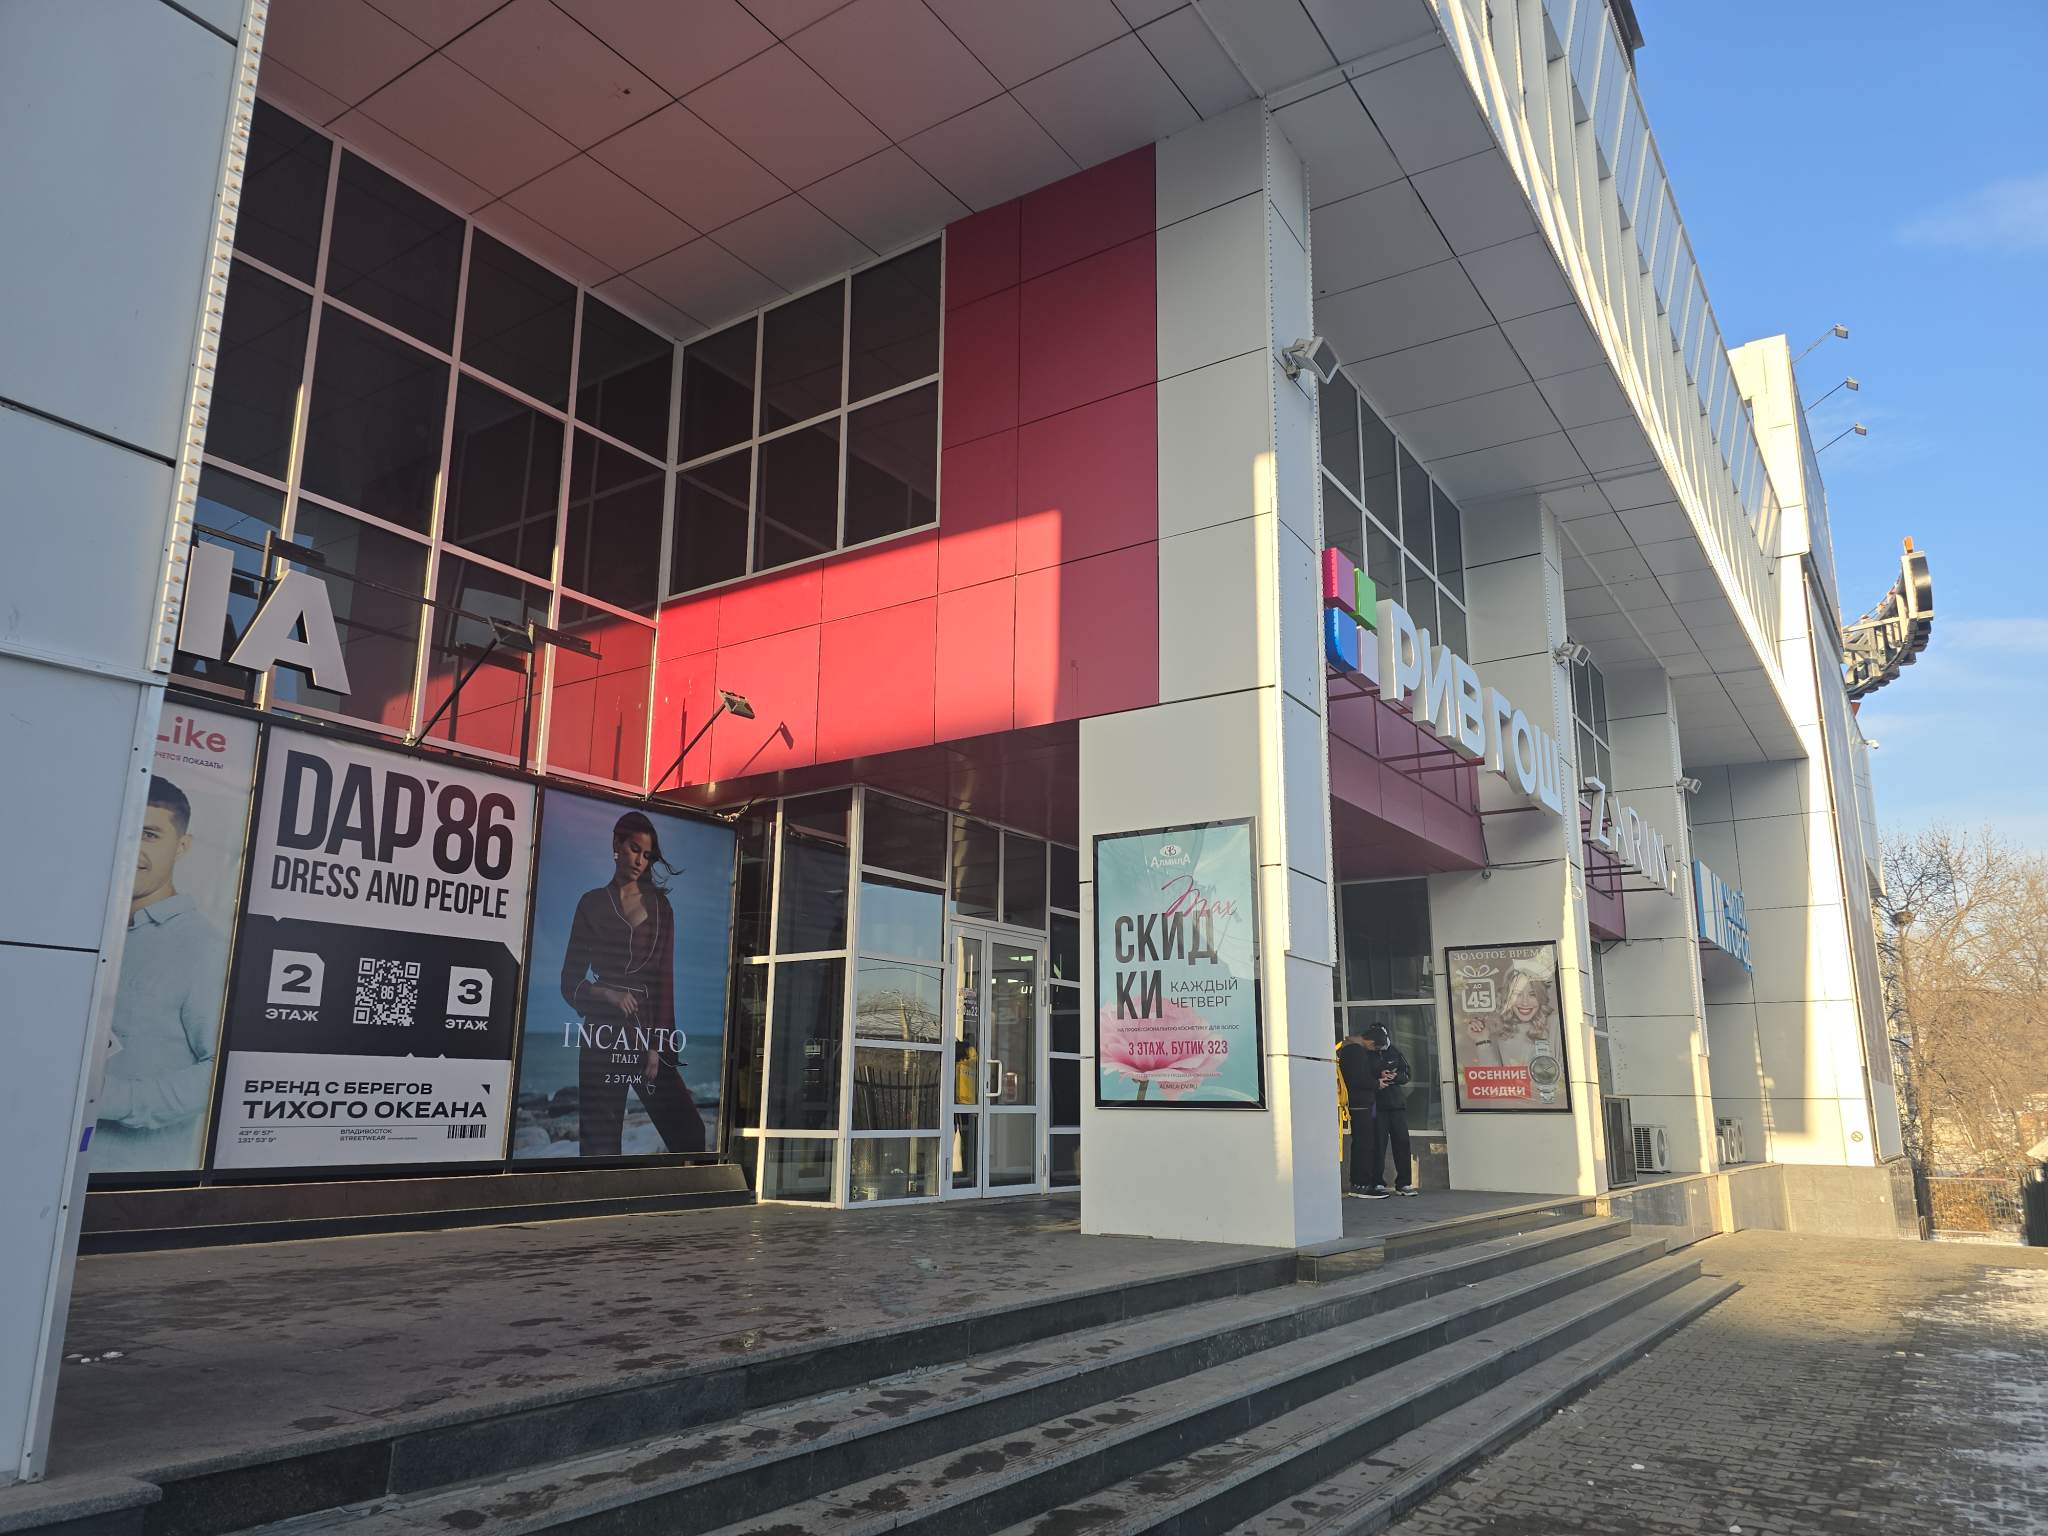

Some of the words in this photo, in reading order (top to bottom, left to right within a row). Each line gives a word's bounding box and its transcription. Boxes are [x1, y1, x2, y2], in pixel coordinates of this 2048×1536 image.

[271, 858, 360, 902] DRESS
[365, 871, 419, 908] AND
[424, 878, 509, 920] PEOPLE
[1114, 908, 1219, 966] СКИД
[1454, 951, 1507, 961] ЗОЛОТОЕ
[281, 963, 313, 994] 2
[1170, 976, 1238, 994] КАЖДЫЙ
[456, 978, 484, 1005] 3
[1116, 970, 1164, 1020] КИ
[1467, 990, 1491, 1008] 45
[1170, 995, 1232, 1009] ЧЕТВЕРГ
[264, 1008, 320, 1023] ЭТАЖ
[444, 1018, 489, 1032] ЭТАЖ
[561, 1022, 687, 1053] INCANTO
[1128, 1042, 1135, 1056] 3
[1137, 1041, 1169, 1056] ЭТАЖ,
[1171, 1040, 1205, 1055] БУТИК
[1208, 1040, 1228, 1055] 323
[611, 1053, 639, 1065] ITALY
[604, 1073, 611, 1085] 2
[613, 1073, 642, 1085] ЭТАЖ
[1468, 1069, 1528, 1080] ОСЕННИЕ
[244, 1080, 320, 1096] БРЕНД
[324, 1081, 340, 1096] С
[343, 1081, 433, 1096] БЕРЕГОВ
[1472, 1085, 1526, 1097] СКИДКИ
[243, 1101, 367, 1120] ТИХОГО
[374, 1101, 488, 1119] ОКЕАНА
